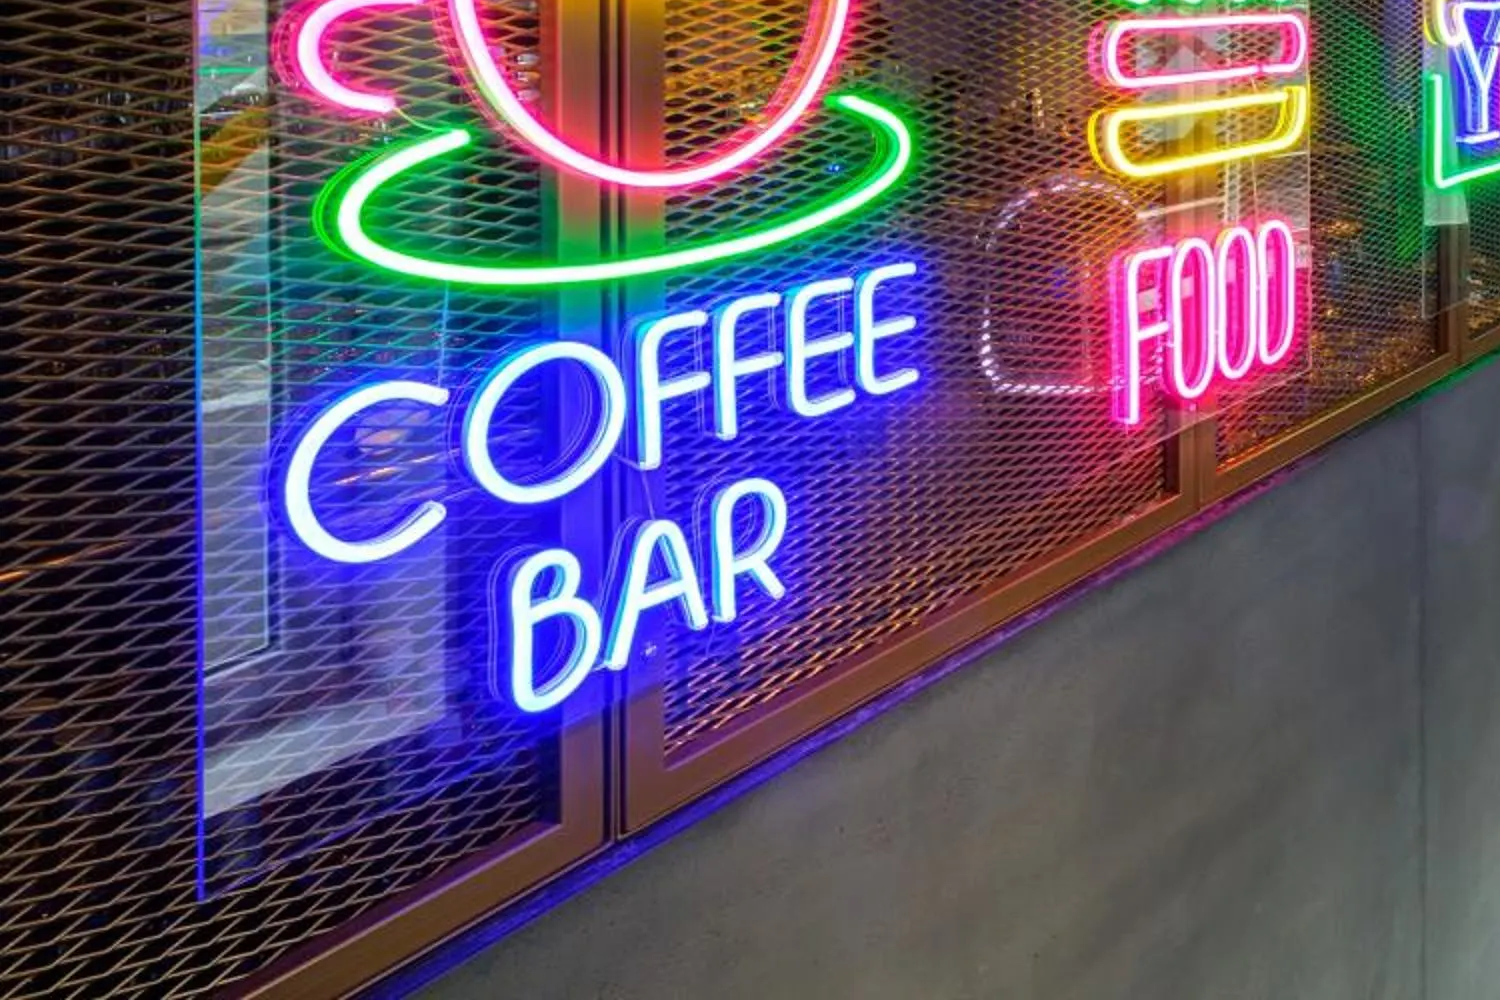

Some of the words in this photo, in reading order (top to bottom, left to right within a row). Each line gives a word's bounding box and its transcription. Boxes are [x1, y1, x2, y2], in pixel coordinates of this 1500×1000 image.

[284, 261, 920, 564] COFFEE
[1124, 219, 1295, 425] FOOD
[510, 477, 788, 713] BAR
